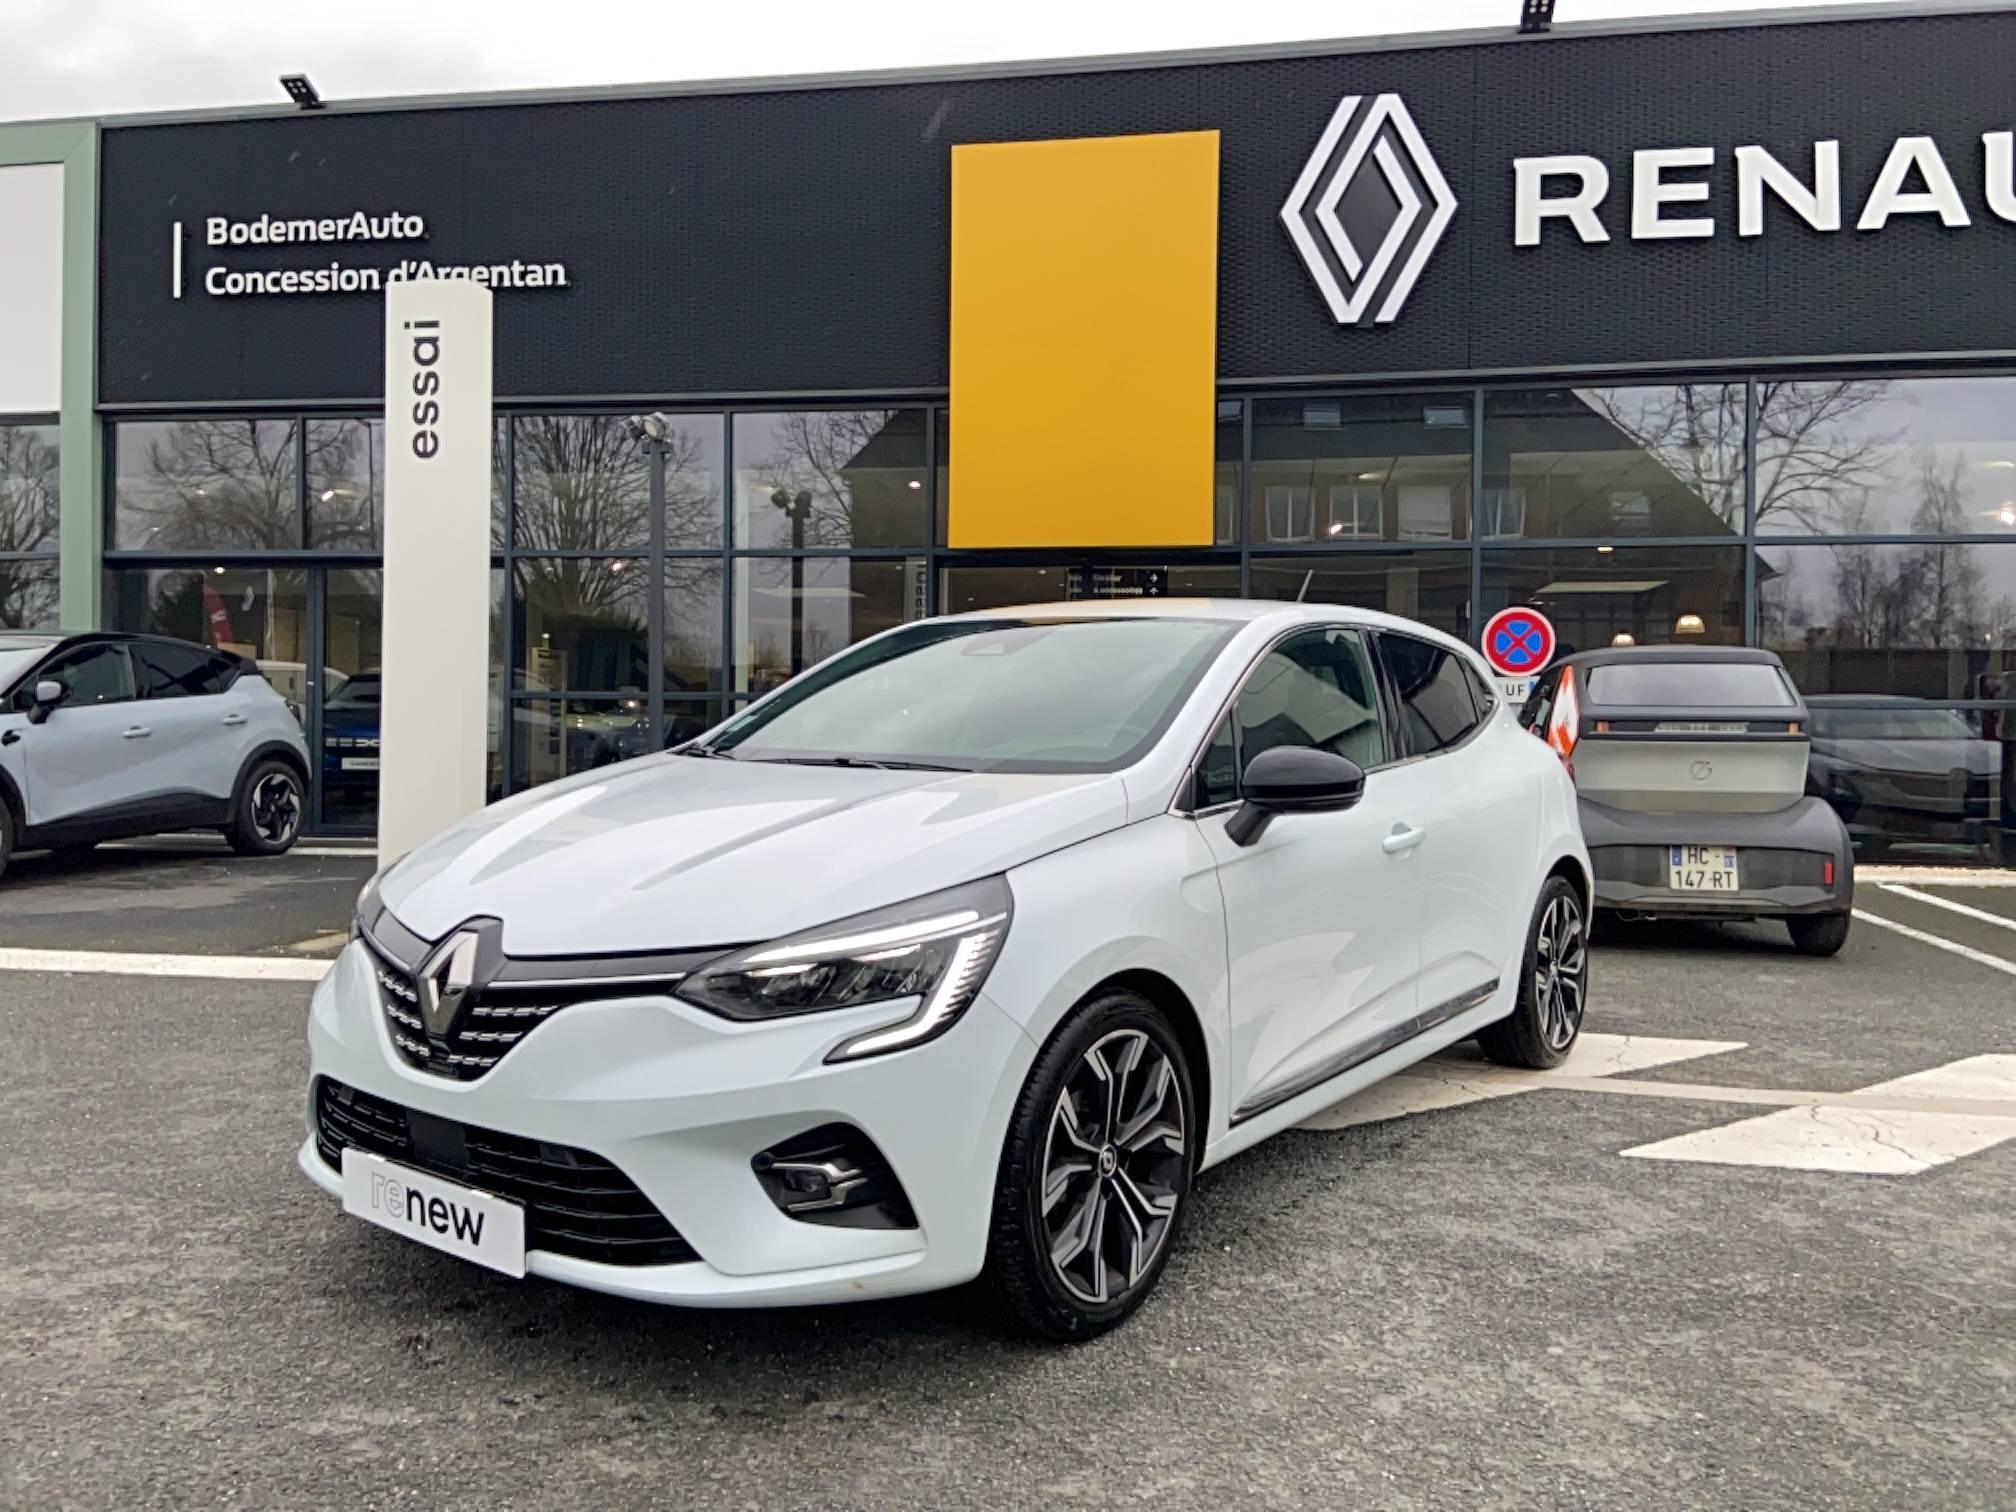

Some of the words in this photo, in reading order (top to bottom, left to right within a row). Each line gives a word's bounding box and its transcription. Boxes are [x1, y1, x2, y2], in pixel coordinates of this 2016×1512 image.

[206, 211, 424, 245] BodemerAuto
[205, 261, 380, 295] Concession
[403, 319, 440, 459] essai
[370, 1171, 485, 1246] renew
